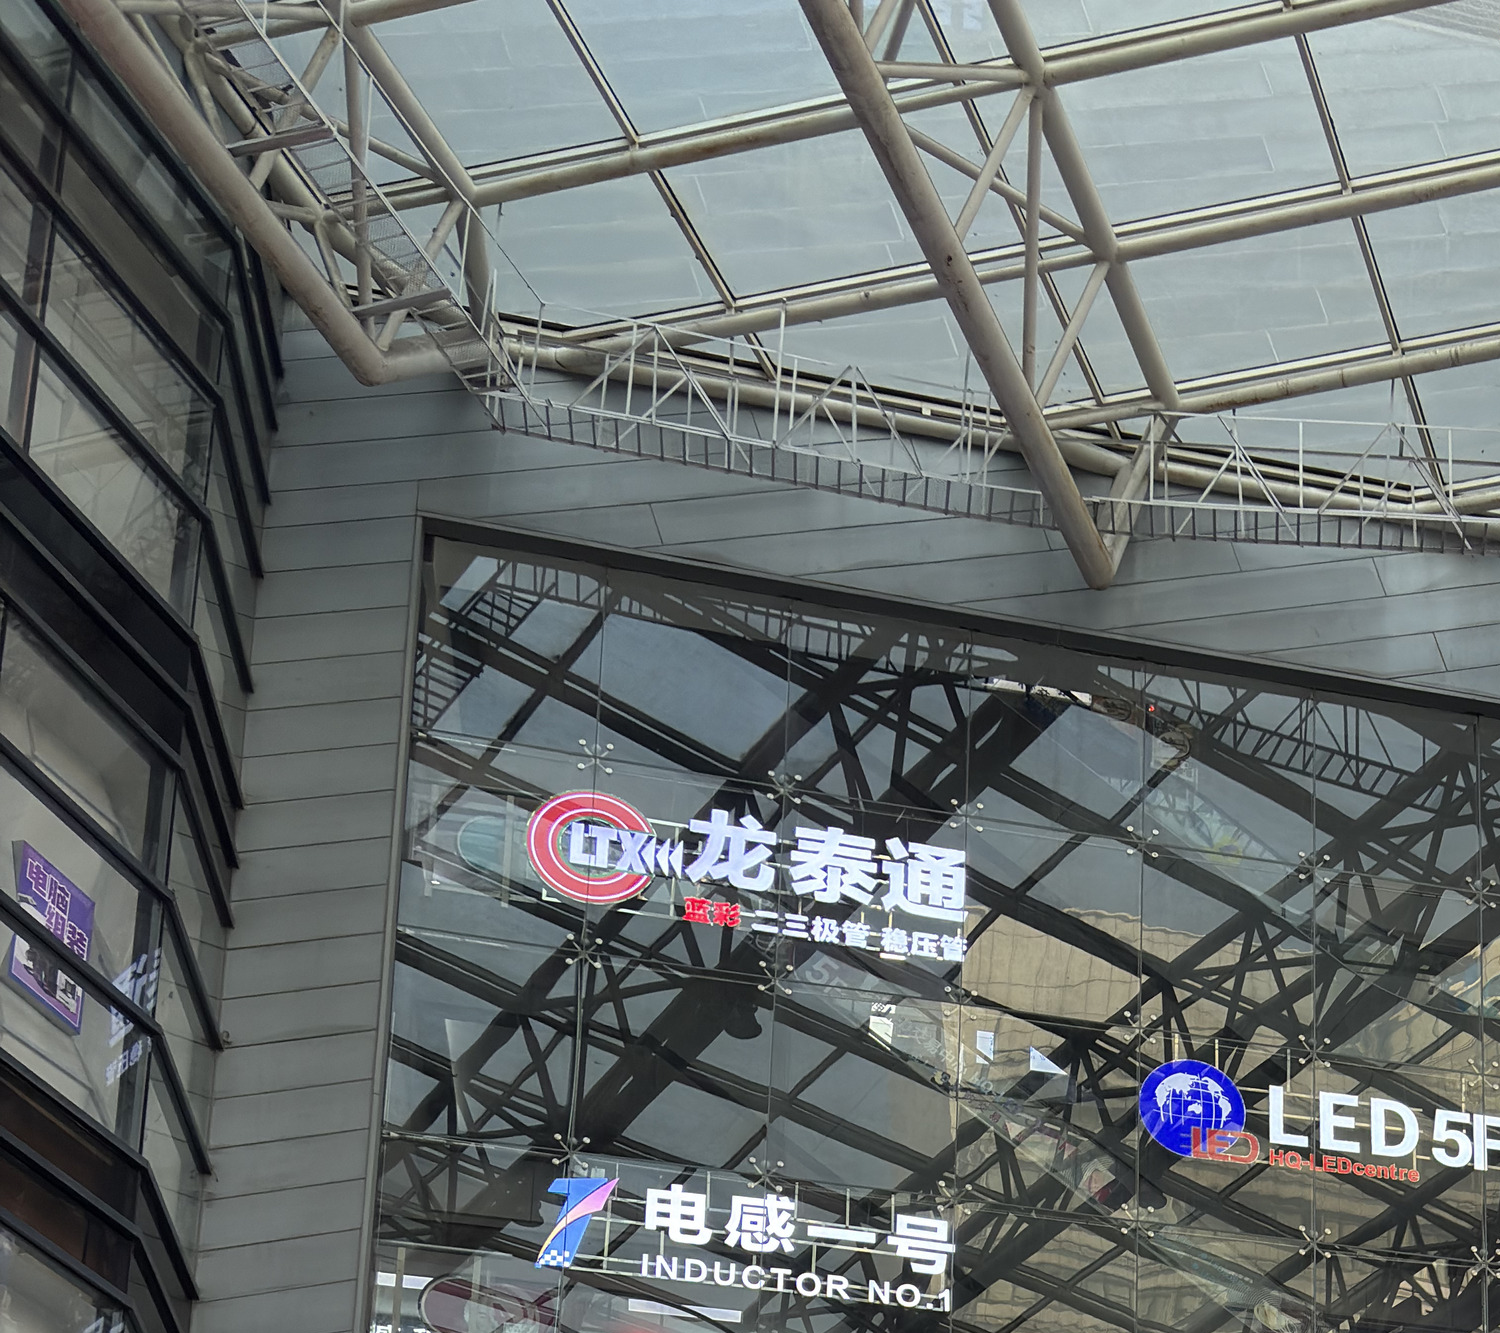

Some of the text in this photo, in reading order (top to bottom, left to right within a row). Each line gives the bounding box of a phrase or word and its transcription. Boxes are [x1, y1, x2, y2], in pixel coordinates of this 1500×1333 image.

[686, 809, 967, 923] 龙泰通
[682, 896, 742, 928] 蓝彩
[751, 909, 870, 948] 二三极管
[1269, 1084, 1420, 1158] LED
[1268, 1148, 1420, 1183] HQ-LEDcentre
[644, 1183, 957, 1277] 电感一号
[640, 1252, 952, 1314] INDUCTOR NO.1
